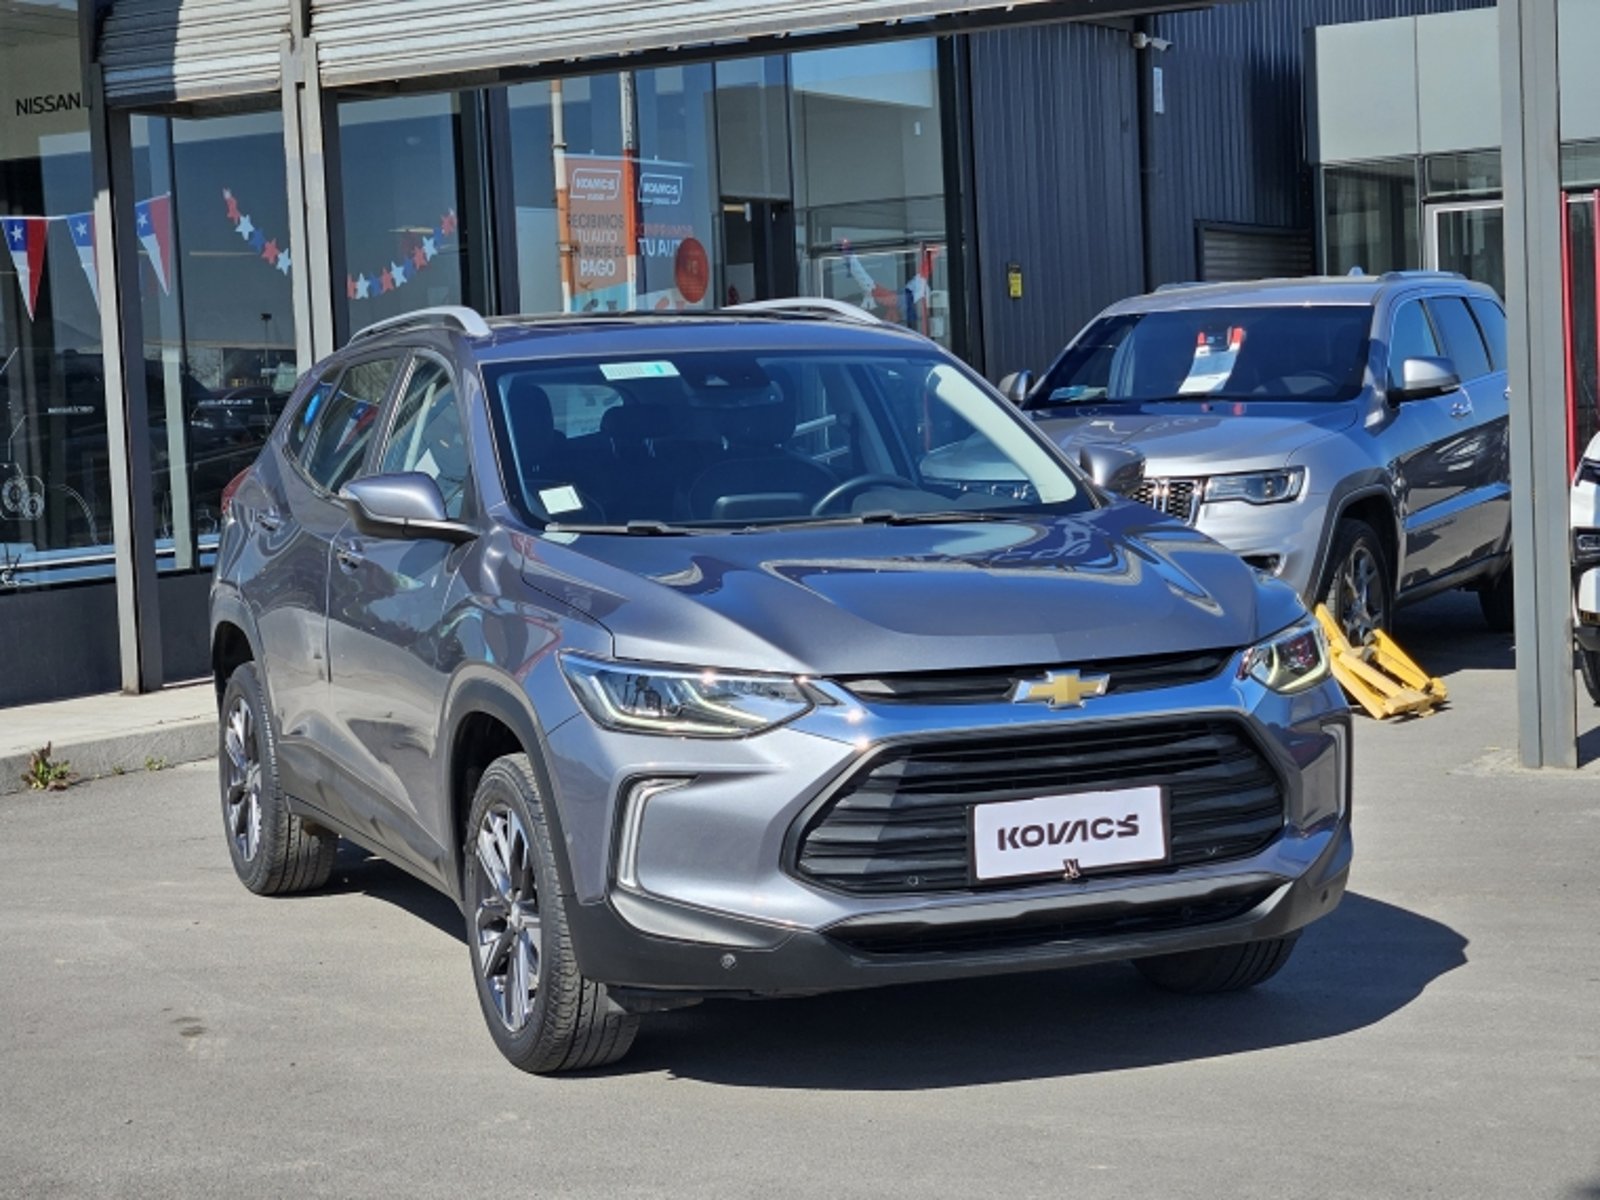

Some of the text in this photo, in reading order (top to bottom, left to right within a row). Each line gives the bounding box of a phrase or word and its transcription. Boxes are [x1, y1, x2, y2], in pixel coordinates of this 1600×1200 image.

[16, 92, 81, 116] NISSAN
[638, 238, 656, 257] TU
[580, 258, 617, 277] PAGO
[997, 814, 1140, 851] KOVACS
